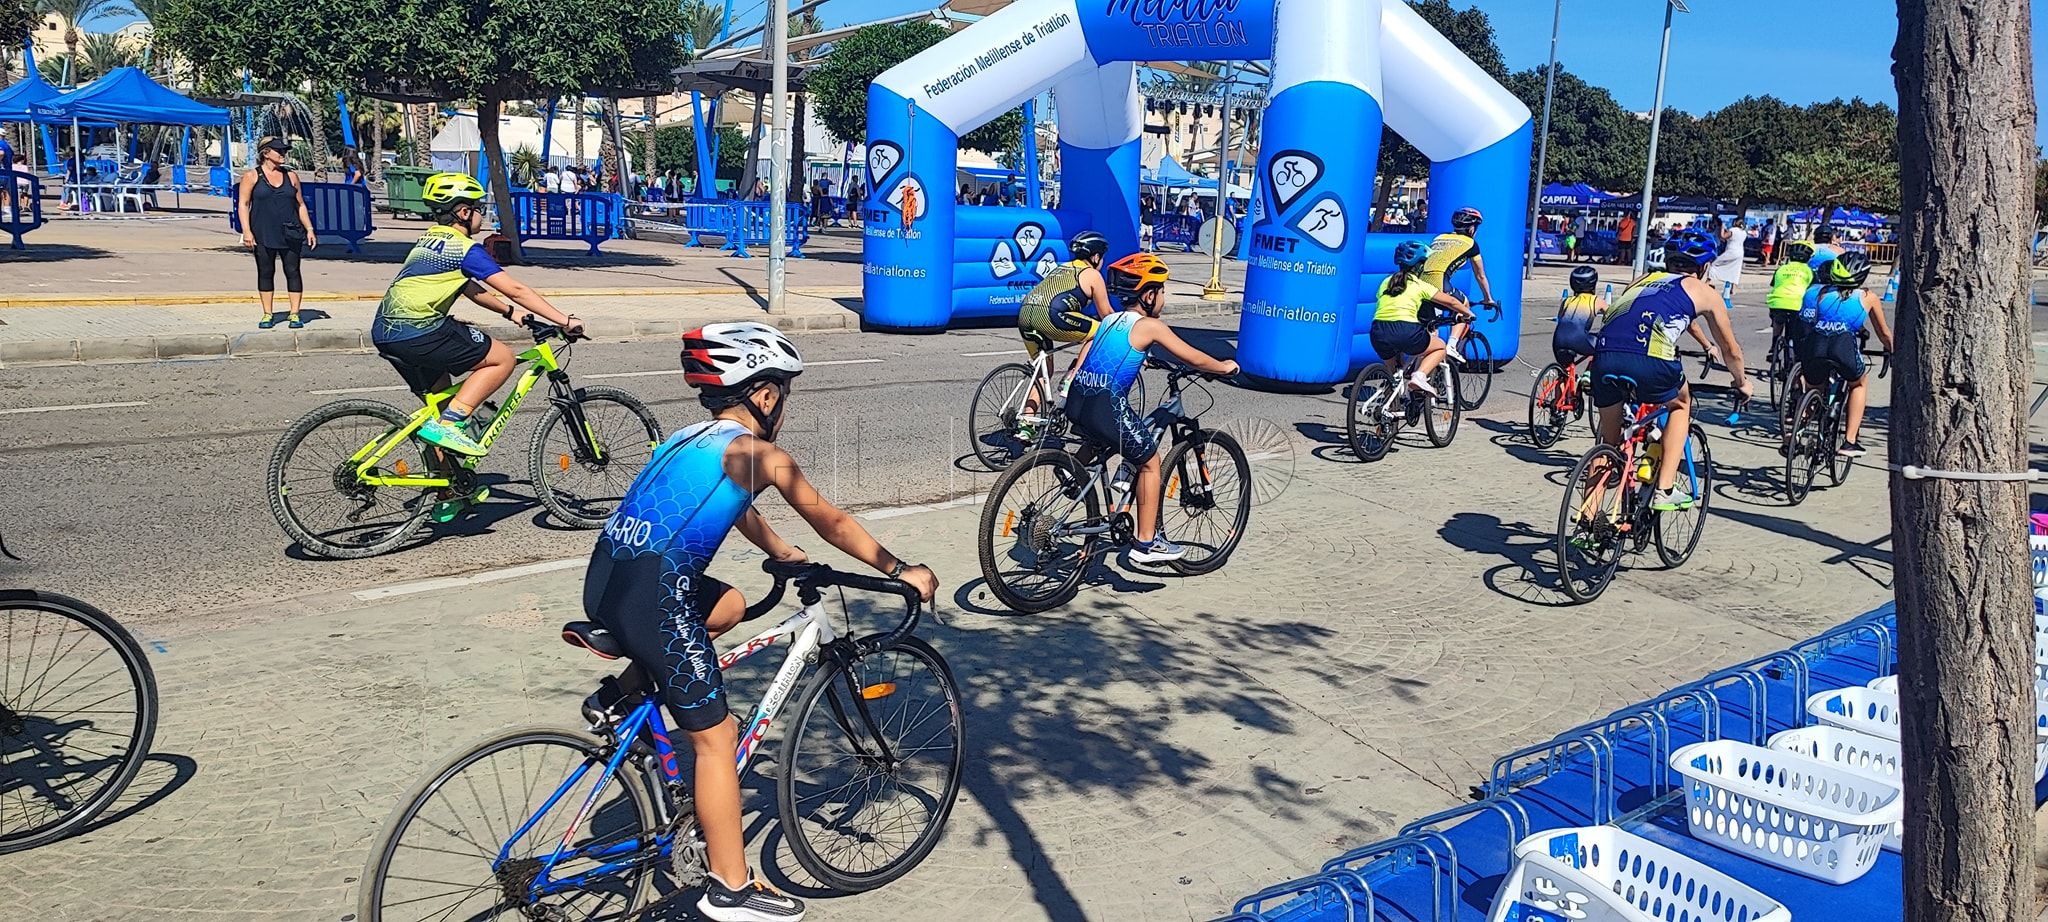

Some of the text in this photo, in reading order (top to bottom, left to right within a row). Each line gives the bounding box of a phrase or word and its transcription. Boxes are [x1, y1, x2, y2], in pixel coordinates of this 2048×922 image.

[1142, 12, 1248, 48] TRIATLÓN
[923, 12, 1071, 99] Federación Melillense de Triatlón
[1541, 195, 1578, 205] CAPITAL
[887, 229, 895, 238] de
[1254, 234, 1299, 253] FMET
[1293, 261, 1304, 273] de
[1307, 260, 1337, 276] Triatlón
[1815, 320, 1848, 331] BLANCA
[484, 392, 522, 449] CKRIDER
[605, 511, 652, 547] MARIO
